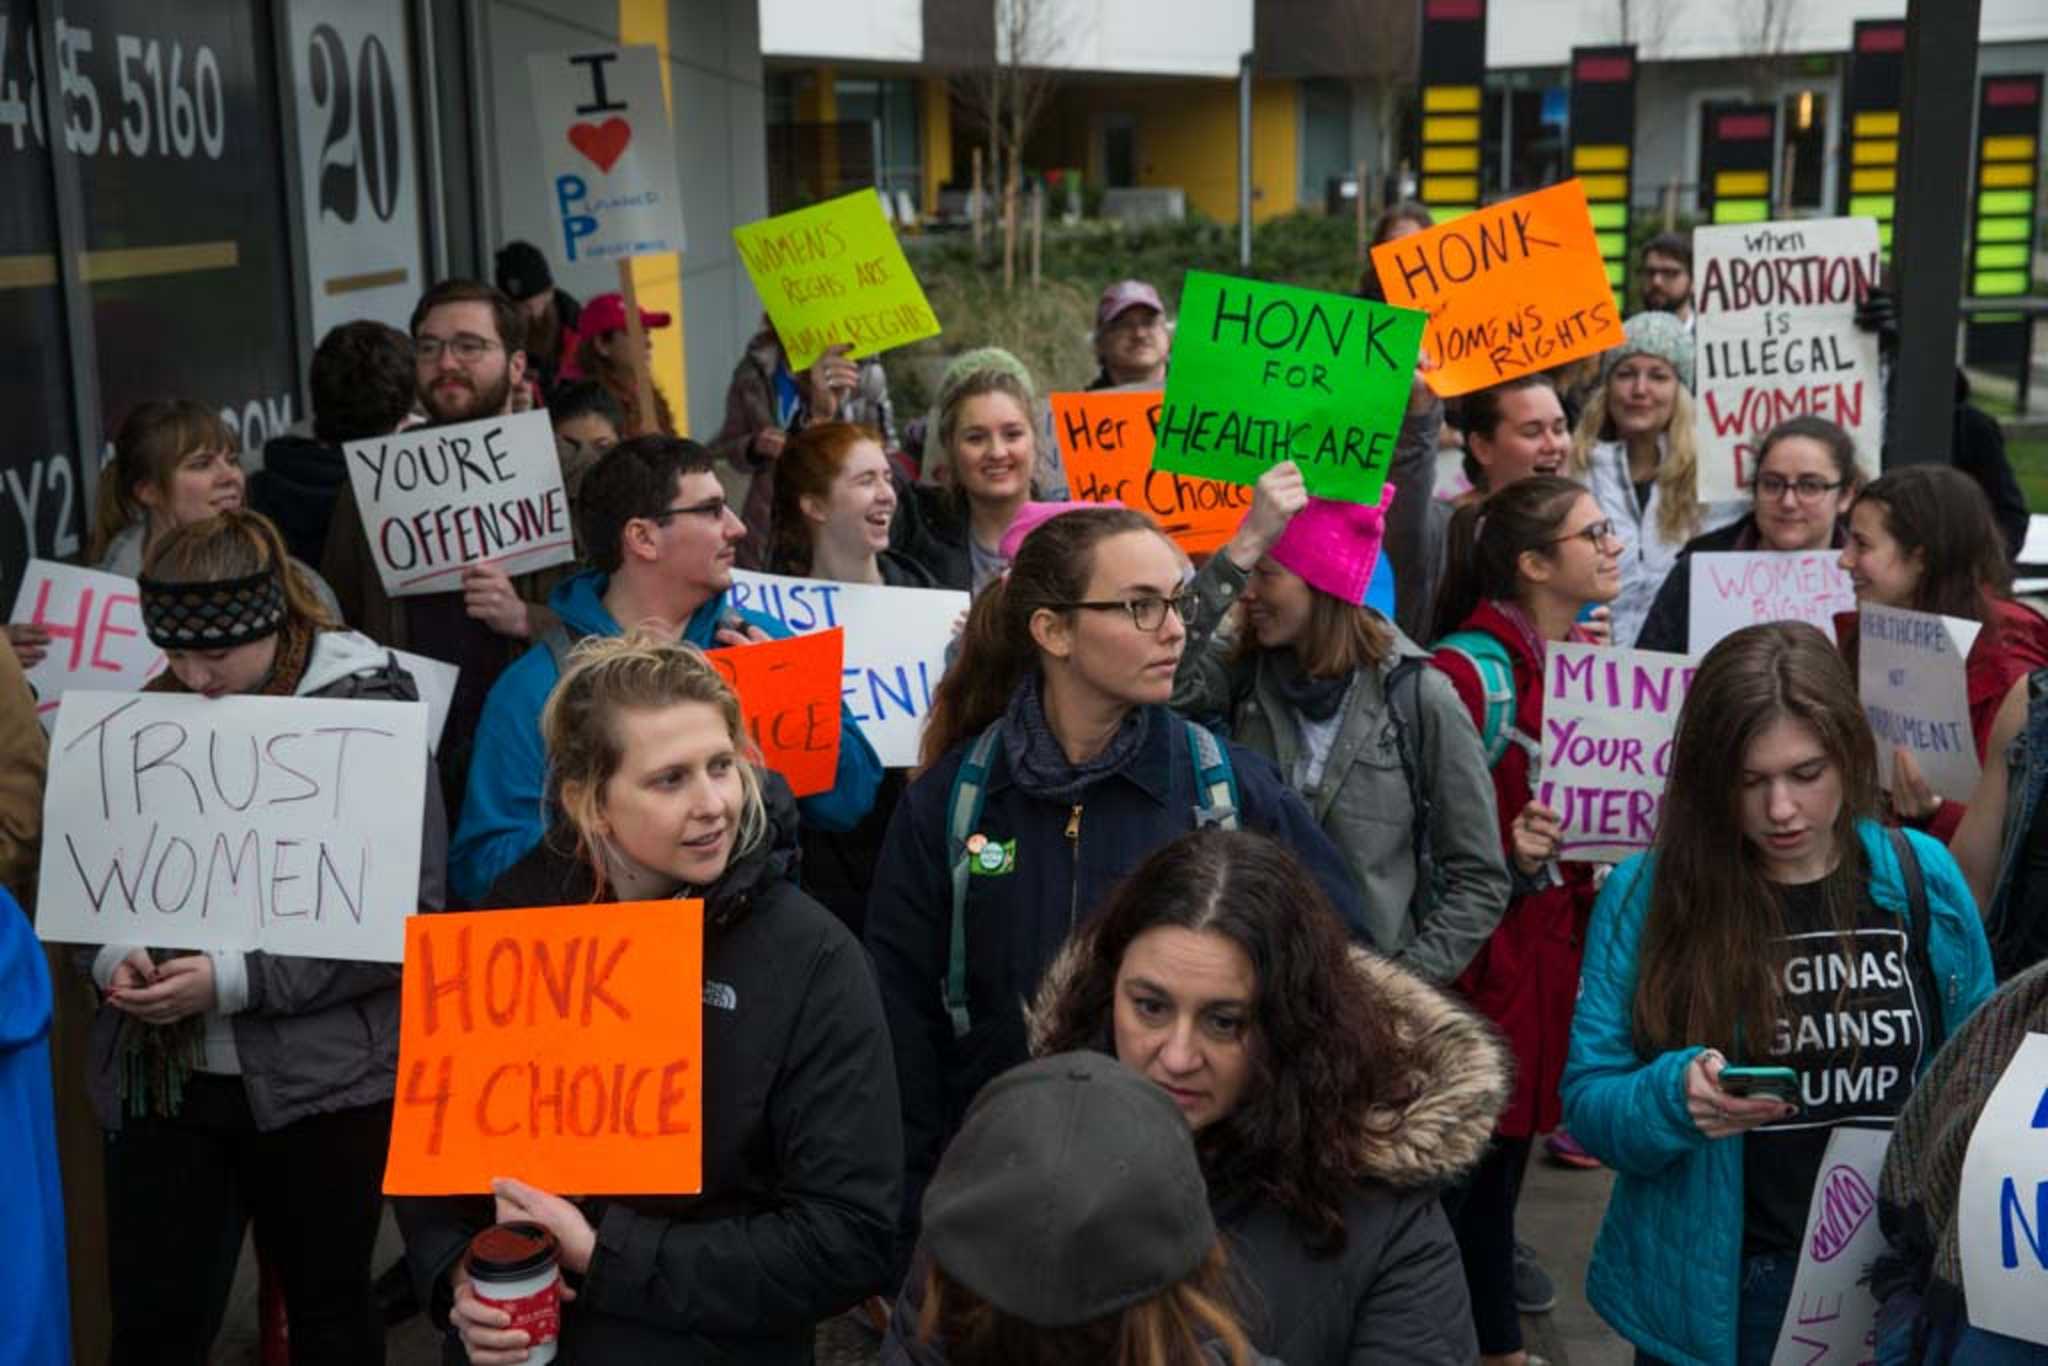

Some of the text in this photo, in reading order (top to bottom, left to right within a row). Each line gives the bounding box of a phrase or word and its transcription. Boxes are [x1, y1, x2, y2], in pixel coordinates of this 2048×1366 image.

[569, 52, 628, 115] I
[308, 22, 400, 224] 20
[1395, 209, 1561, 300] HONK
[1700, 252, 1877, 315] ABORTION
[1211, 287, 1400, 371] HONK
[1490, 302, 1612, 377] RIGHTS
[1705, 335, 1855, 379] ILLEGAL
[1262, 359, 1334, 395] FOR
[1704, 380, 1864, 438] WOMEN
[1064, 405, 1128, 451] Her
[1160, 402, 1394, 470] HEALTHCARE
[356, 427, 517, 502] YOU'RE
[1076, 471, 1132, 502] Her
[380, 487, 565, 572] OFFENSIVE
[64, 698, 396, 821] TRUST
[1547, 718, 1645, 776] YOUR
[1540, 781, 1665, 840] UTER
[64, 822, 373, 929] WOMEN
[419, 924, 632, 1037] HONK
[402, 1055, 692, 1157] 4 CHOICE
